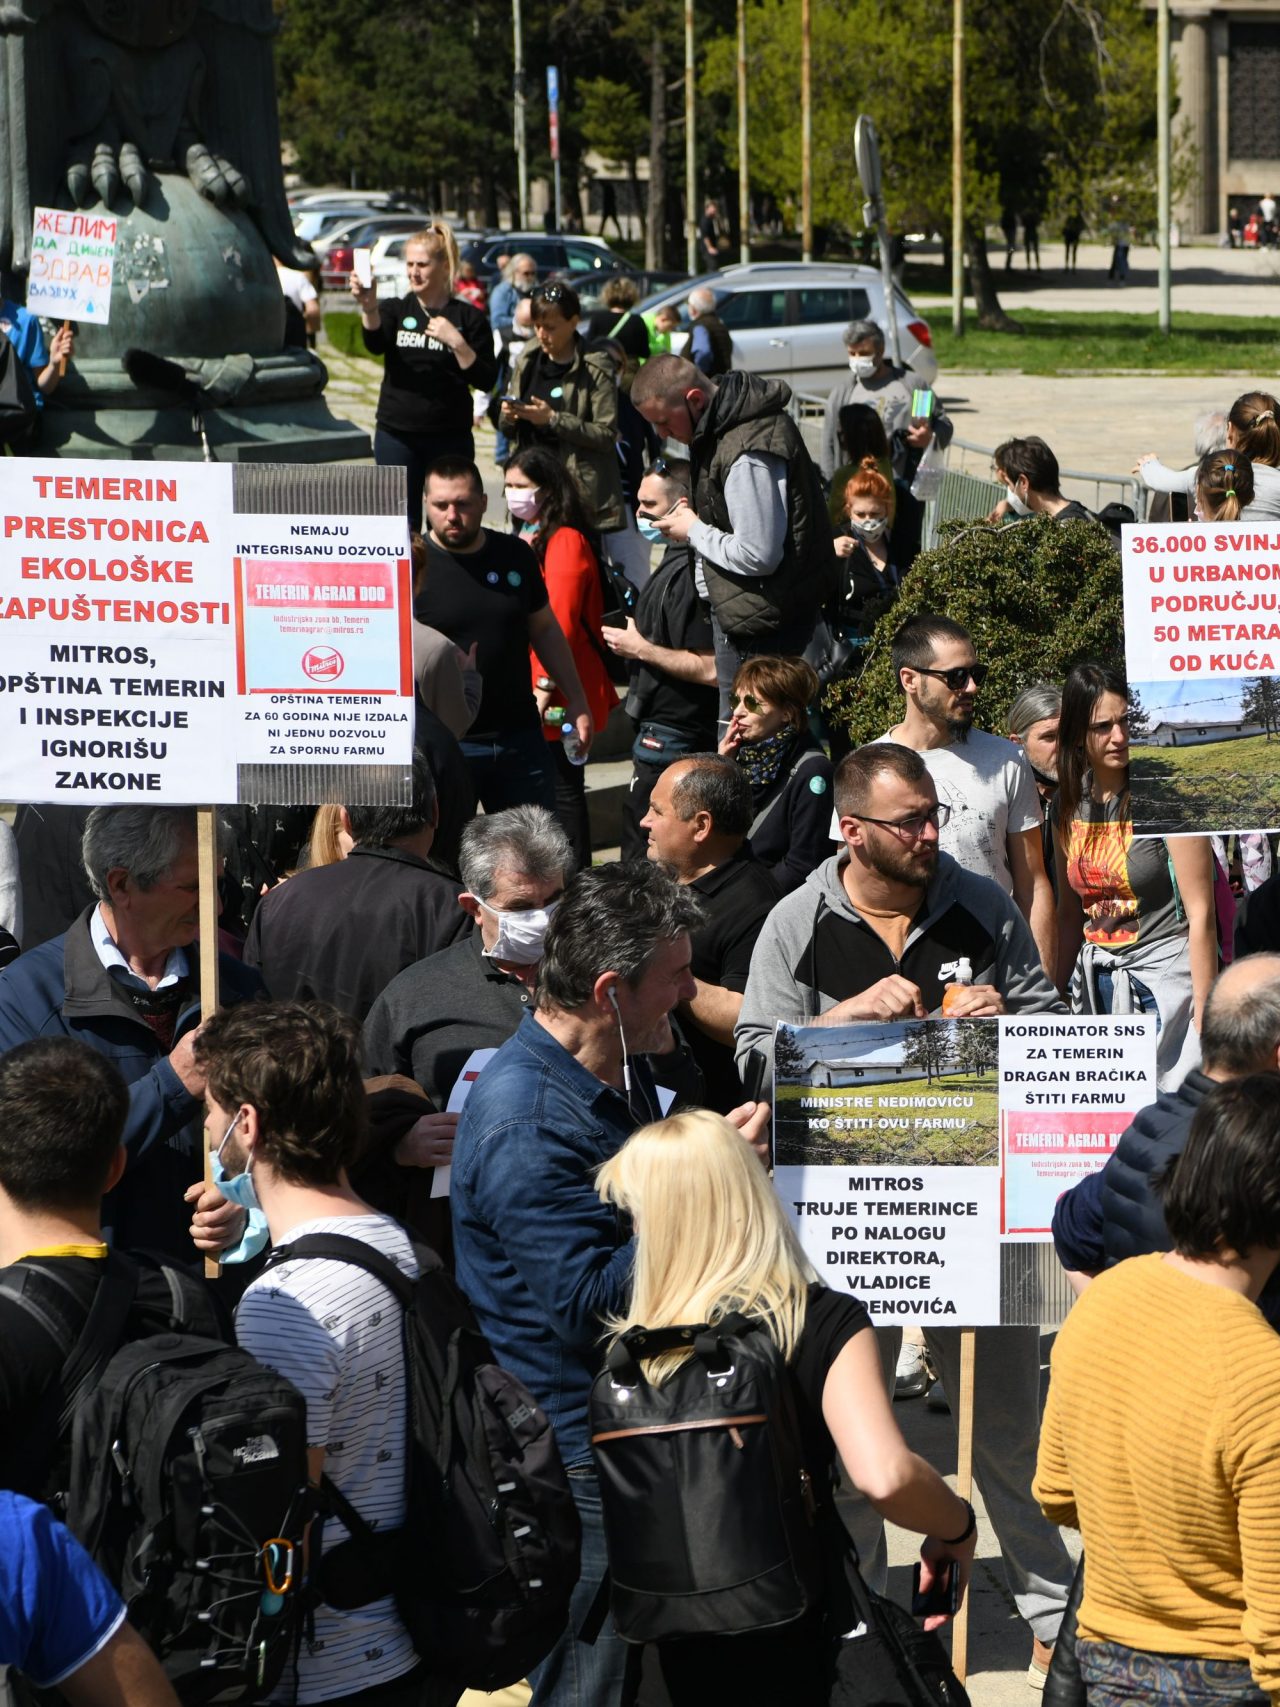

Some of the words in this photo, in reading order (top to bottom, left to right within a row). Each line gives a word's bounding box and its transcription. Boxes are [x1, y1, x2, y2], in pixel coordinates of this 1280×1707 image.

[37, 213, 117, 242] ЖЕЛИМ
[33, 236, 57, 250] ДА
[32, 254, 111, 287] ЗДРАВ
[33, 476, 177, 502] TEMERIN
[4, 516, 209, 544] PRESTONICA
[290, 526, 349, 536] NEMAJU
[236, 545, 333, 555] INTEGRISANU
[339, 546, 404, 556] DOZVOLU
[1132, 537, 1206, 553] 36.000
[21, 555, 194, 583] EKOLOŠKE
[1149, 567, 1164, 582] U
[256, 584, 309, 600] TEMERIN
[314, 586, 355, 601] AGRAR
[359, 587, 385, 601] DOO
[0, 594, 229, 624] APUŠTENOSTI
[1154, 626, 1180, 642] 50
[50, 645, 156, 668] MITROS,
[1170, 655, 1201, 671] OD
[1210, 650, 1275, 671] KUĆA
[111, 677, 225, 697] TEMERIN
[271, 694, 323, 704] OPŠTINA
[328, 696, 381, 705] TEMERIN
[20, 708, 26, 724] I
[36, 708, 189, 729] INSPEKCIJE
[245, 712, 261, 721] ZA
[265, 712, 278, 721] 60
[283, 712, 329, 721] GODINA
[334, 713, 360, 721] NIJE
[365, 713, 408, 722] IZDALA
[268, 729, 280, 737] NI
[285, 729, 324, 738] JEDNU
[329, 730, 386, 738] DOZVOLU
[41, 736, 167, 759] IGNORIŠU
[270, 746, 285, 754] ZA
[290, 746, 339, 755] SPORNU
[344, 746, 385, 755] FARMU
[55, 771, 161, 791] ZAKONE
[1005, 1025, 1108, 1037] KORDINATOR
[1114, 1025, 1145, 1036] SNS
[1026, 1048, 1047, 1059] ZA
[1052, 1047, 1124, 1059] TEMERIN
[1004, 1070, 1070, 1082] DRAGAN
[1076, 1067, 1147, 1081] BRAČIKA
[800, 1096, 873, 1108] MINISTRE
[1025, 1091, 1065, 1104] ŠTITI
[1072, 1093, 1125, 1104] FARMU
[808, 1118, 830, 1129] KO
[835, 1115, 872, 1129] ŠTITI
[878, 1117, 909, 1129] OVU
[914, 1117, 966, 1129] FARMU
[1016, 1133, 1064, 1147] TEMERIN
[1068, 1133, 1105, 1147] AGRAR
[849, 1177, 924, 1191] MITROS
[794, 1201, 857, 1215] TRUJE
[864, 1201, 978, 1215] TEMERINCE
[831, 1227, 856, 1241] PO
[864, 1226, 946, 1240] NALOGU
[827, 1251, 946, 1267] DIREKTORA,
[846, 1275, 931, 1290] VLADICE
